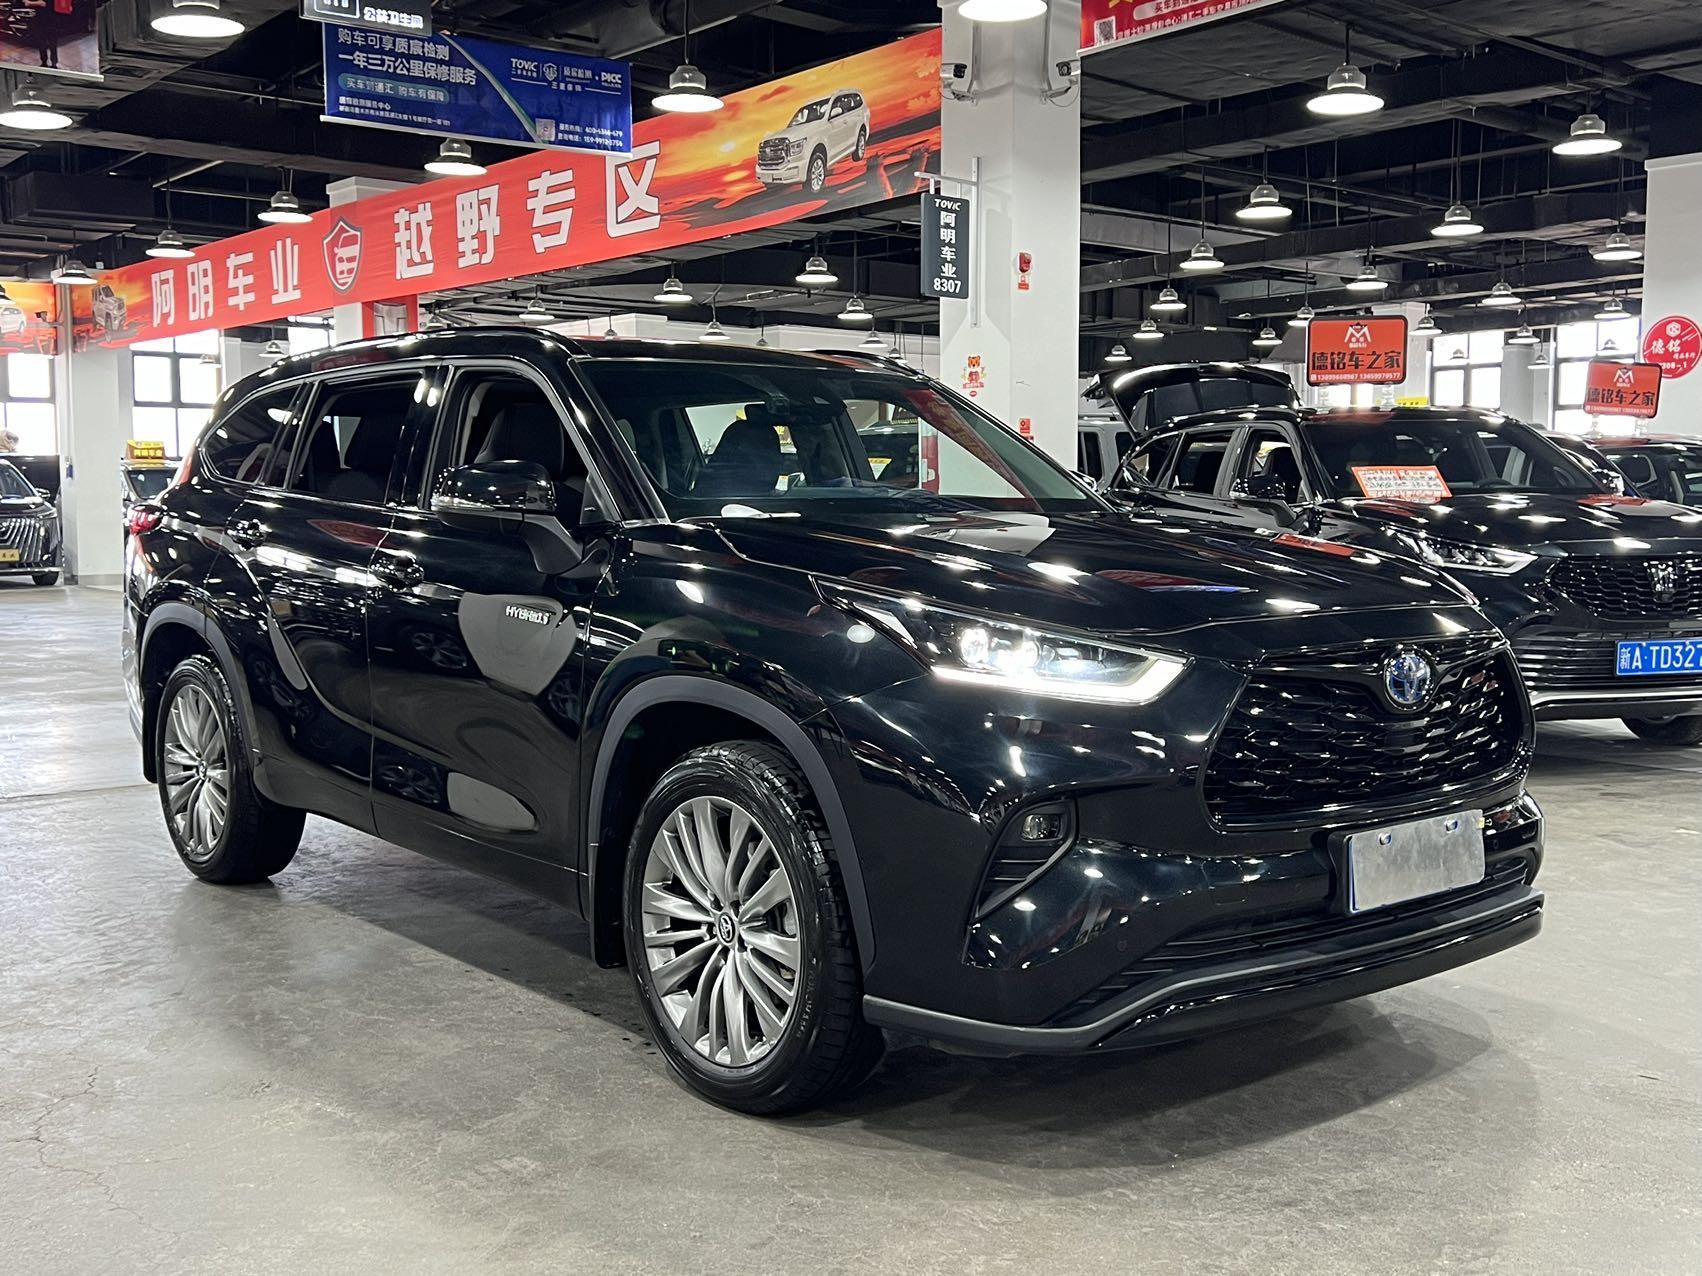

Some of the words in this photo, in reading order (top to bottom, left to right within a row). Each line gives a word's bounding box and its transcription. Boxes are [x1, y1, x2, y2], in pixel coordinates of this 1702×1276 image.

[338, 51, 477, 85] 一年三万公里保修服务
[934, 198, 962, 210] TOVIC
[151, 237, 301, 328] 阿明车业
[393, 140, 662, 280] 越野专区
[940, 211, 957, 278] 阿明车业
[933, 278, 962, 293] 8307
[1312, 351, 1402, 370] 德铭车之家
[1659, 361, 1687, 369] 308-1
[1587, 388, 1655, 406] 德铭车之家
